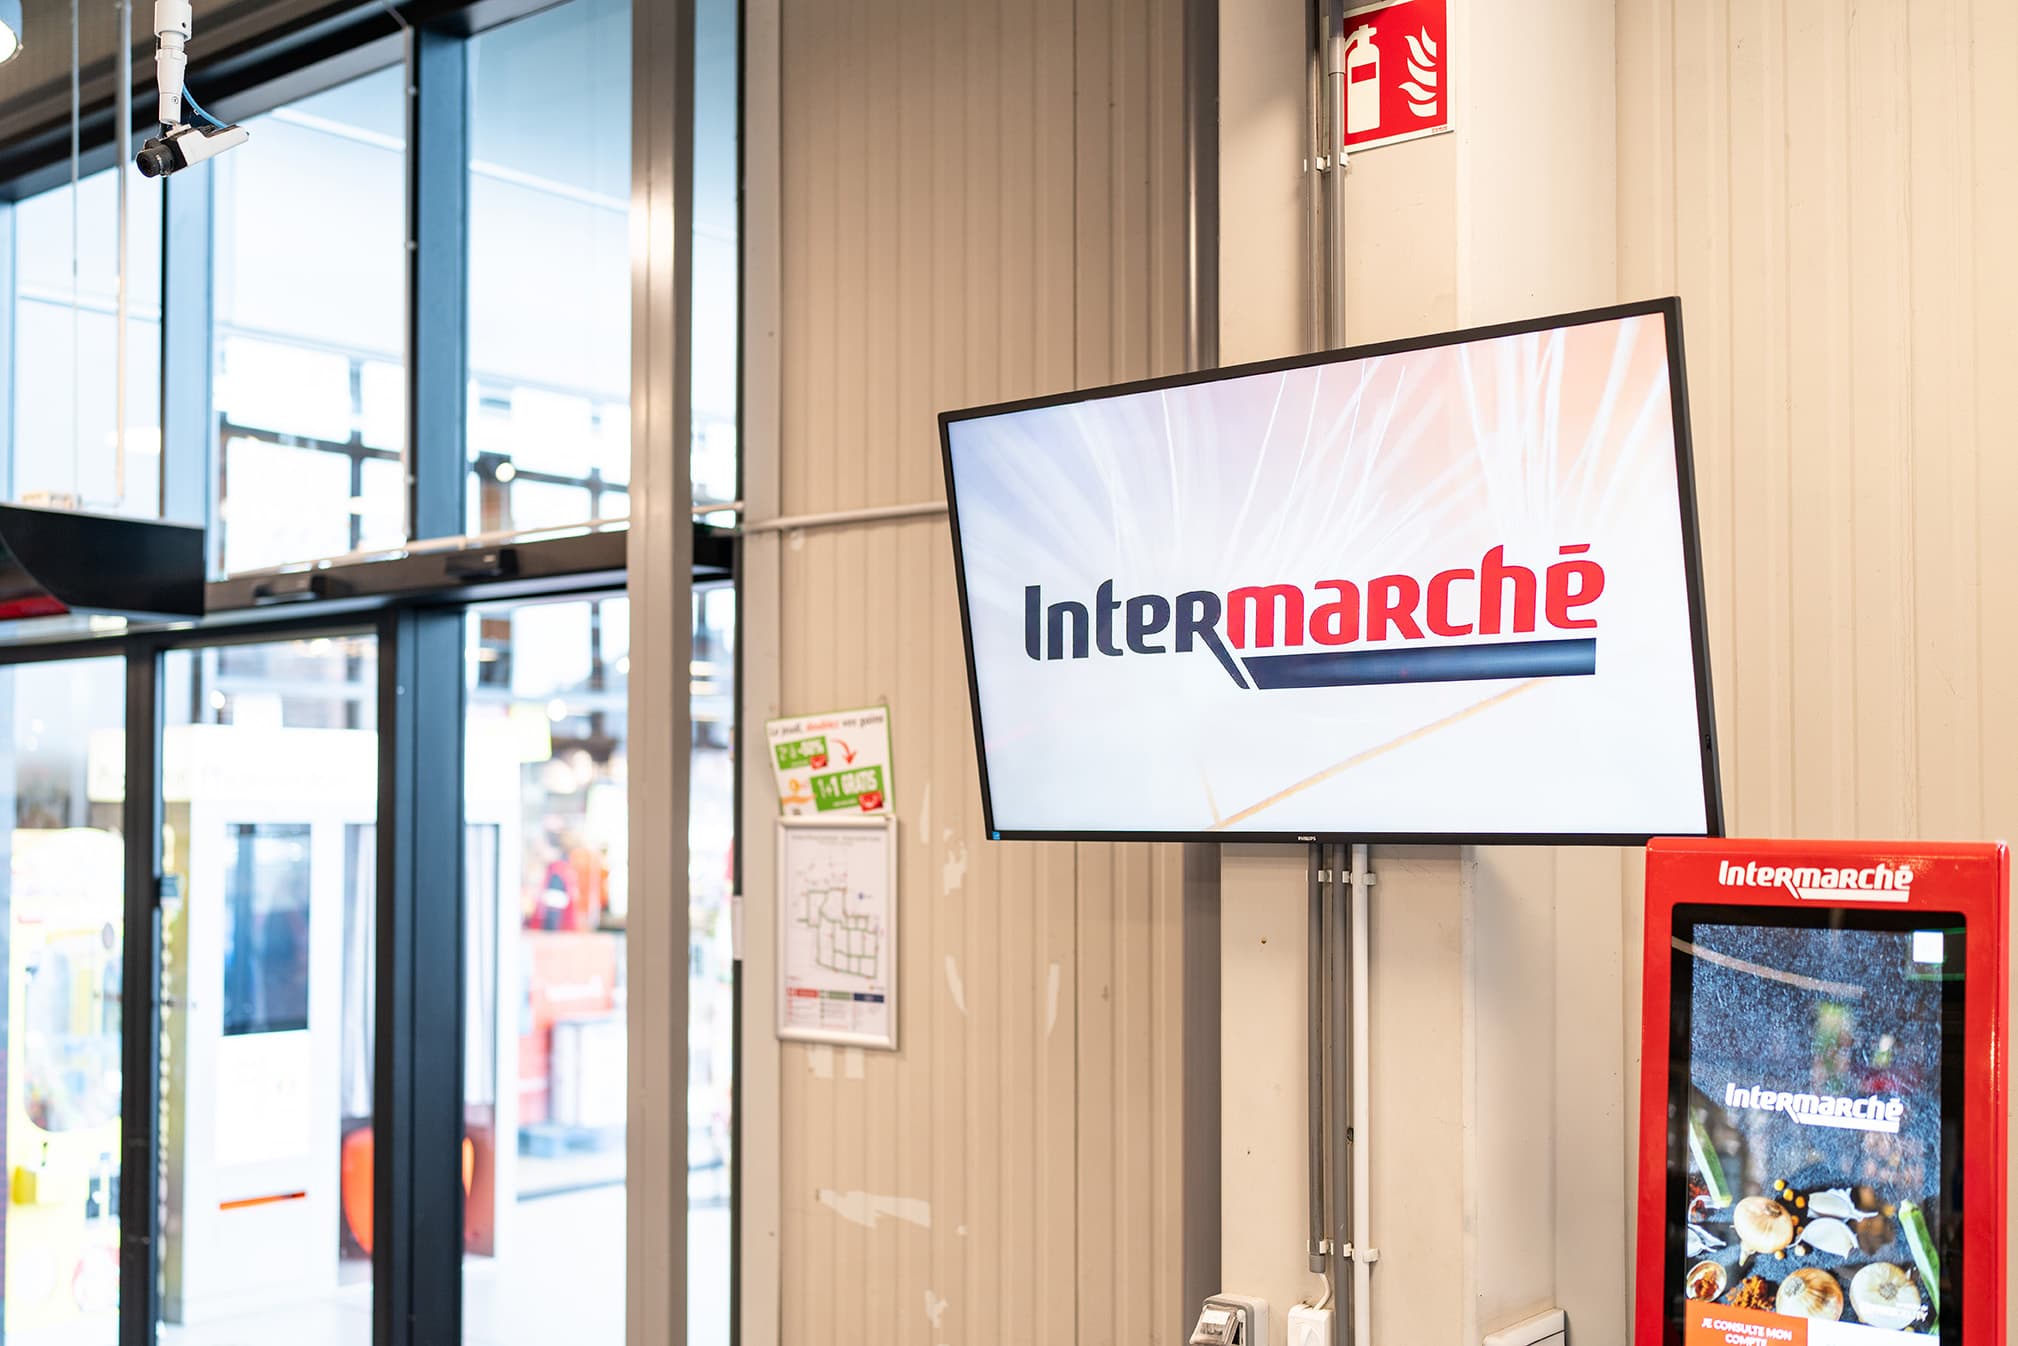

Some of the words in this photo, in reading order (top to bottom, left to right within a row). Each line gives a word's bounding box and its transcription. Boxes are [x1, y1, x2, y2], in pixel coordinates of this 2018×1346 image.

[1025, 544, 1605, 690] Intermarché
[817, 775, 841, 799] 1+1
[840, 769, 878, 796] GRATIS
[1718, 860, 1914, 900] Intermarché
[1724, 1082, 1904, 1125] Intermarché
[1701, 1317, 1713, 1329] JE
[1713, 1319, 1765, 1337] CONSULTE
[1766, 1328, 1793, 1341] MON
[1725, 1333, 1768, 1346] COMPTE
